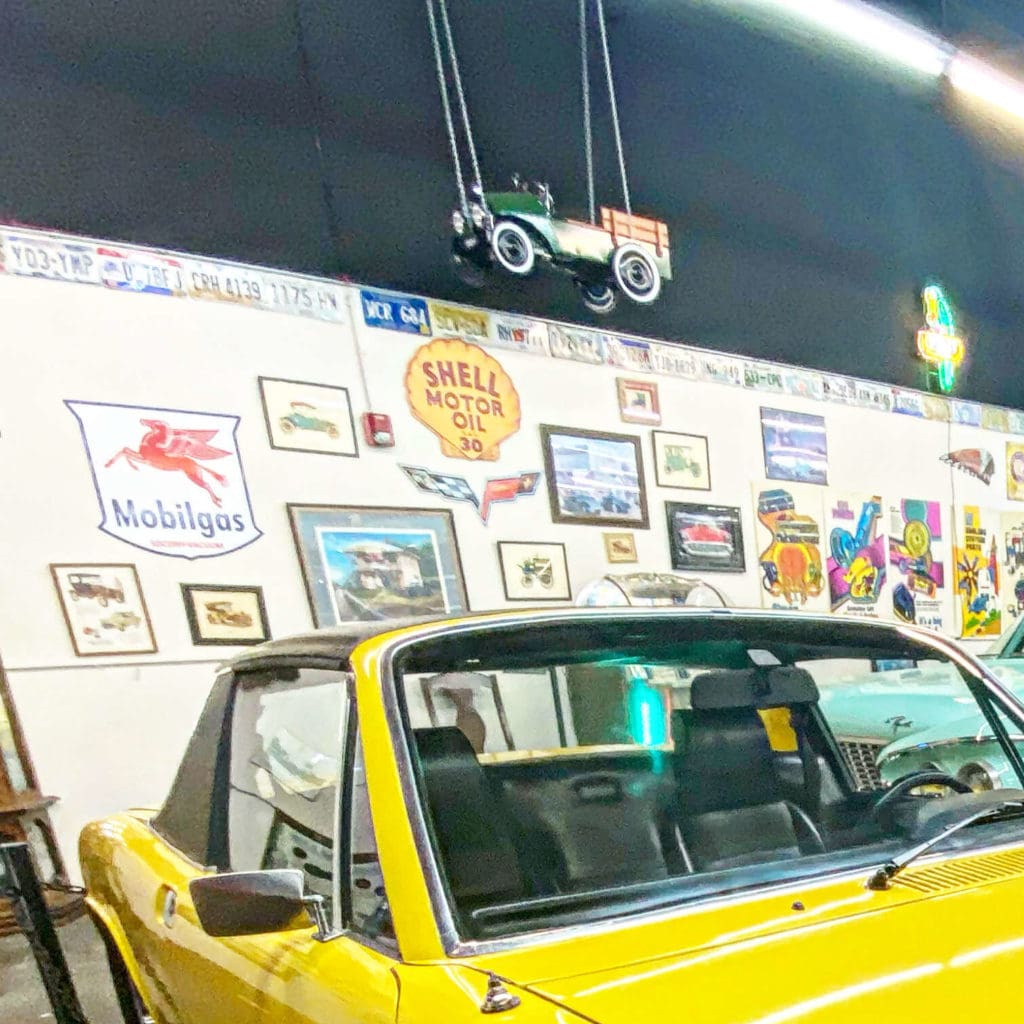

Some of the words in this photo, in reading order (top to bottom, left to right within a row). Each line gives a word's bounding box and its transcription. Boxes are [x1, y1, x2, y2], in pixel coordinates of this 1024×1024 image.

[422, 360, 500, 398] SHELL
[425, 388, 506, 418] MOTOR
[453, 411, 487, 433] OIL
[460, 436, 484, 453] 30
[111, 498, 245, 538] Mobilgas
